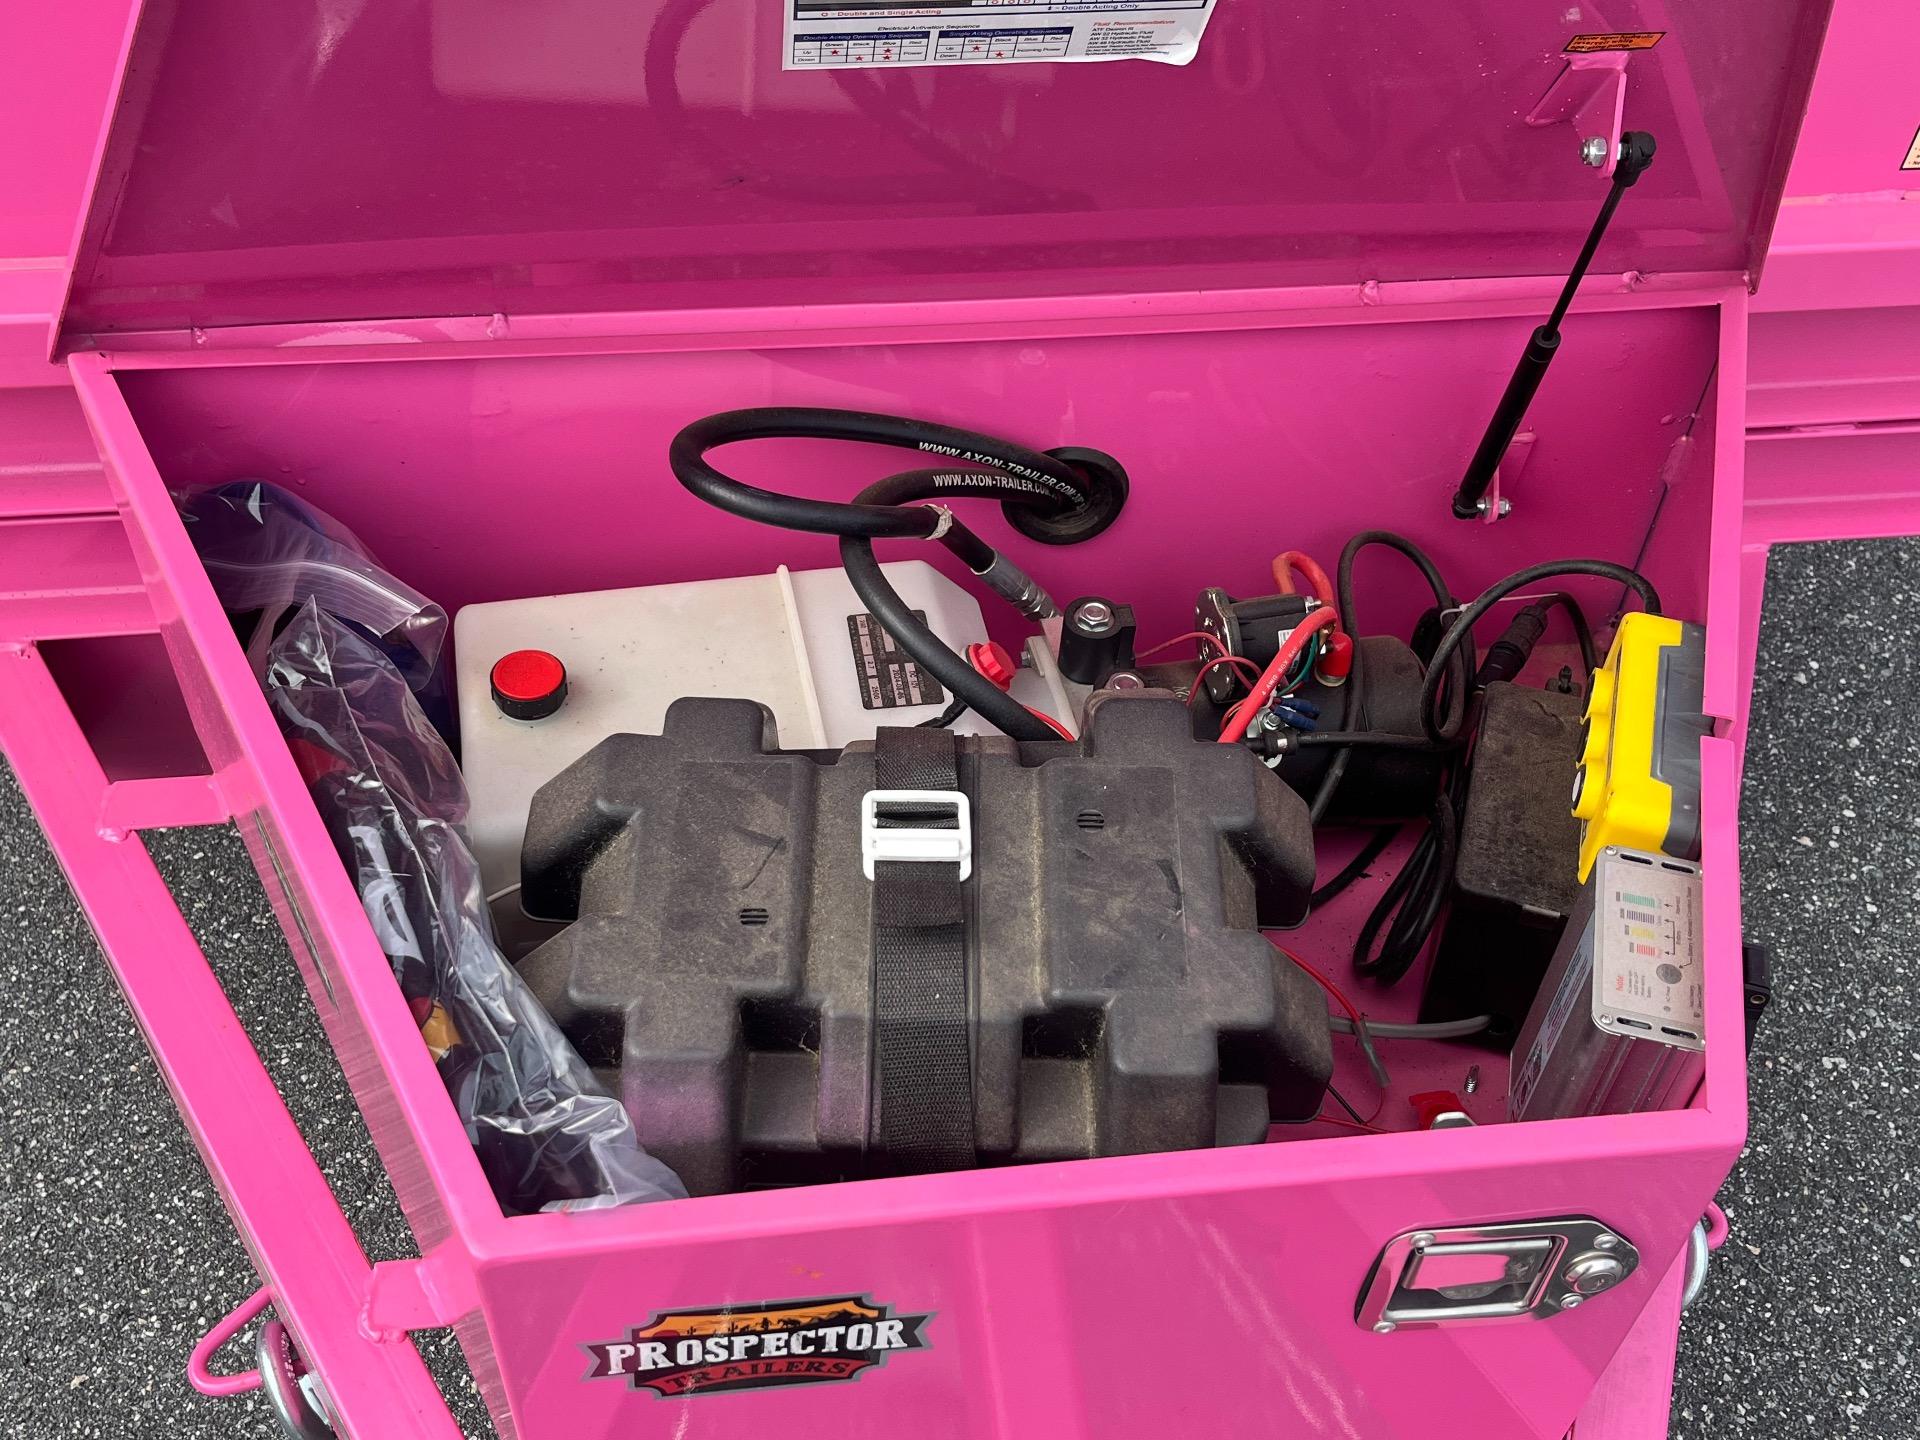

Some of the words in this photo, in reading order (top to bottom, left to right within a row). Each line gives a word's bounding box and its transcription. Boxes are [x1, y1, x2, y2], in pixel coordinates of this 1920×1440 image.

[1266, 674, 1278, 689] AWG
[606, 1320, 908, 1375] PROSPECTOR
[666, 1360, 851, 1394] TRAILERS
